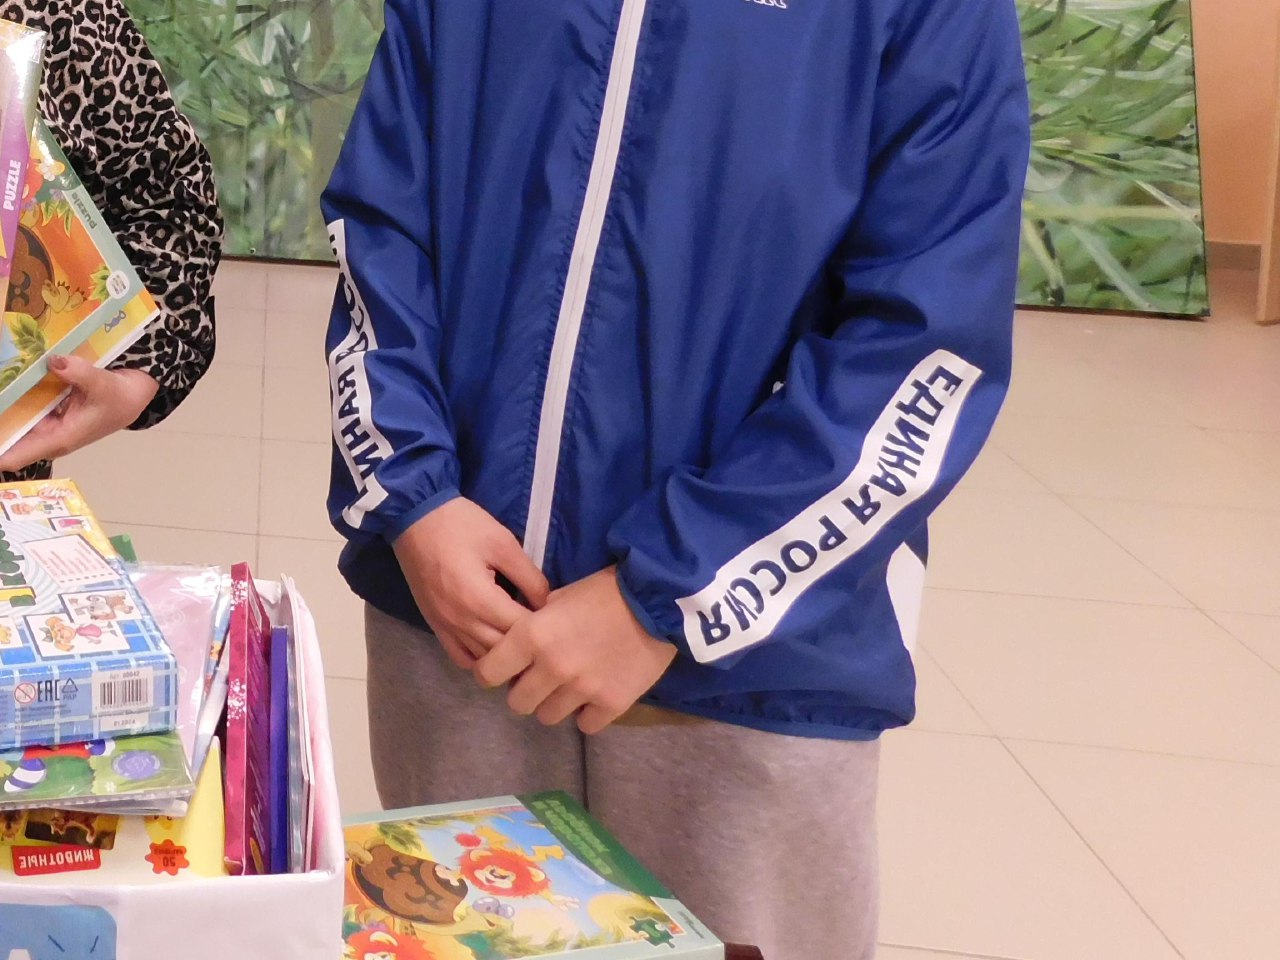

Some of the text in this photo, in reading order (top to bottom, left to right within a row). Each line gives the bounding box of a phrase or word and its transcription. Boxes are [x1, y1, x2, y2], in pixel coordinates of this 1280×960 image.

[3, 159, 21, 211] PUZZLE
[71, 192, 98, 229] puzzle
[337, 365, 385, 498] ИНАЯ
[696, 365, 964, 646] ЕДИНАЯ РОССИЯ
[37, 679, 60, 703] EAC
[62, 692, 78, 700] PAP
[19, 848, 95, 869] ЖИВОТНЫЕ
[163, 856, 177, 867] 50
